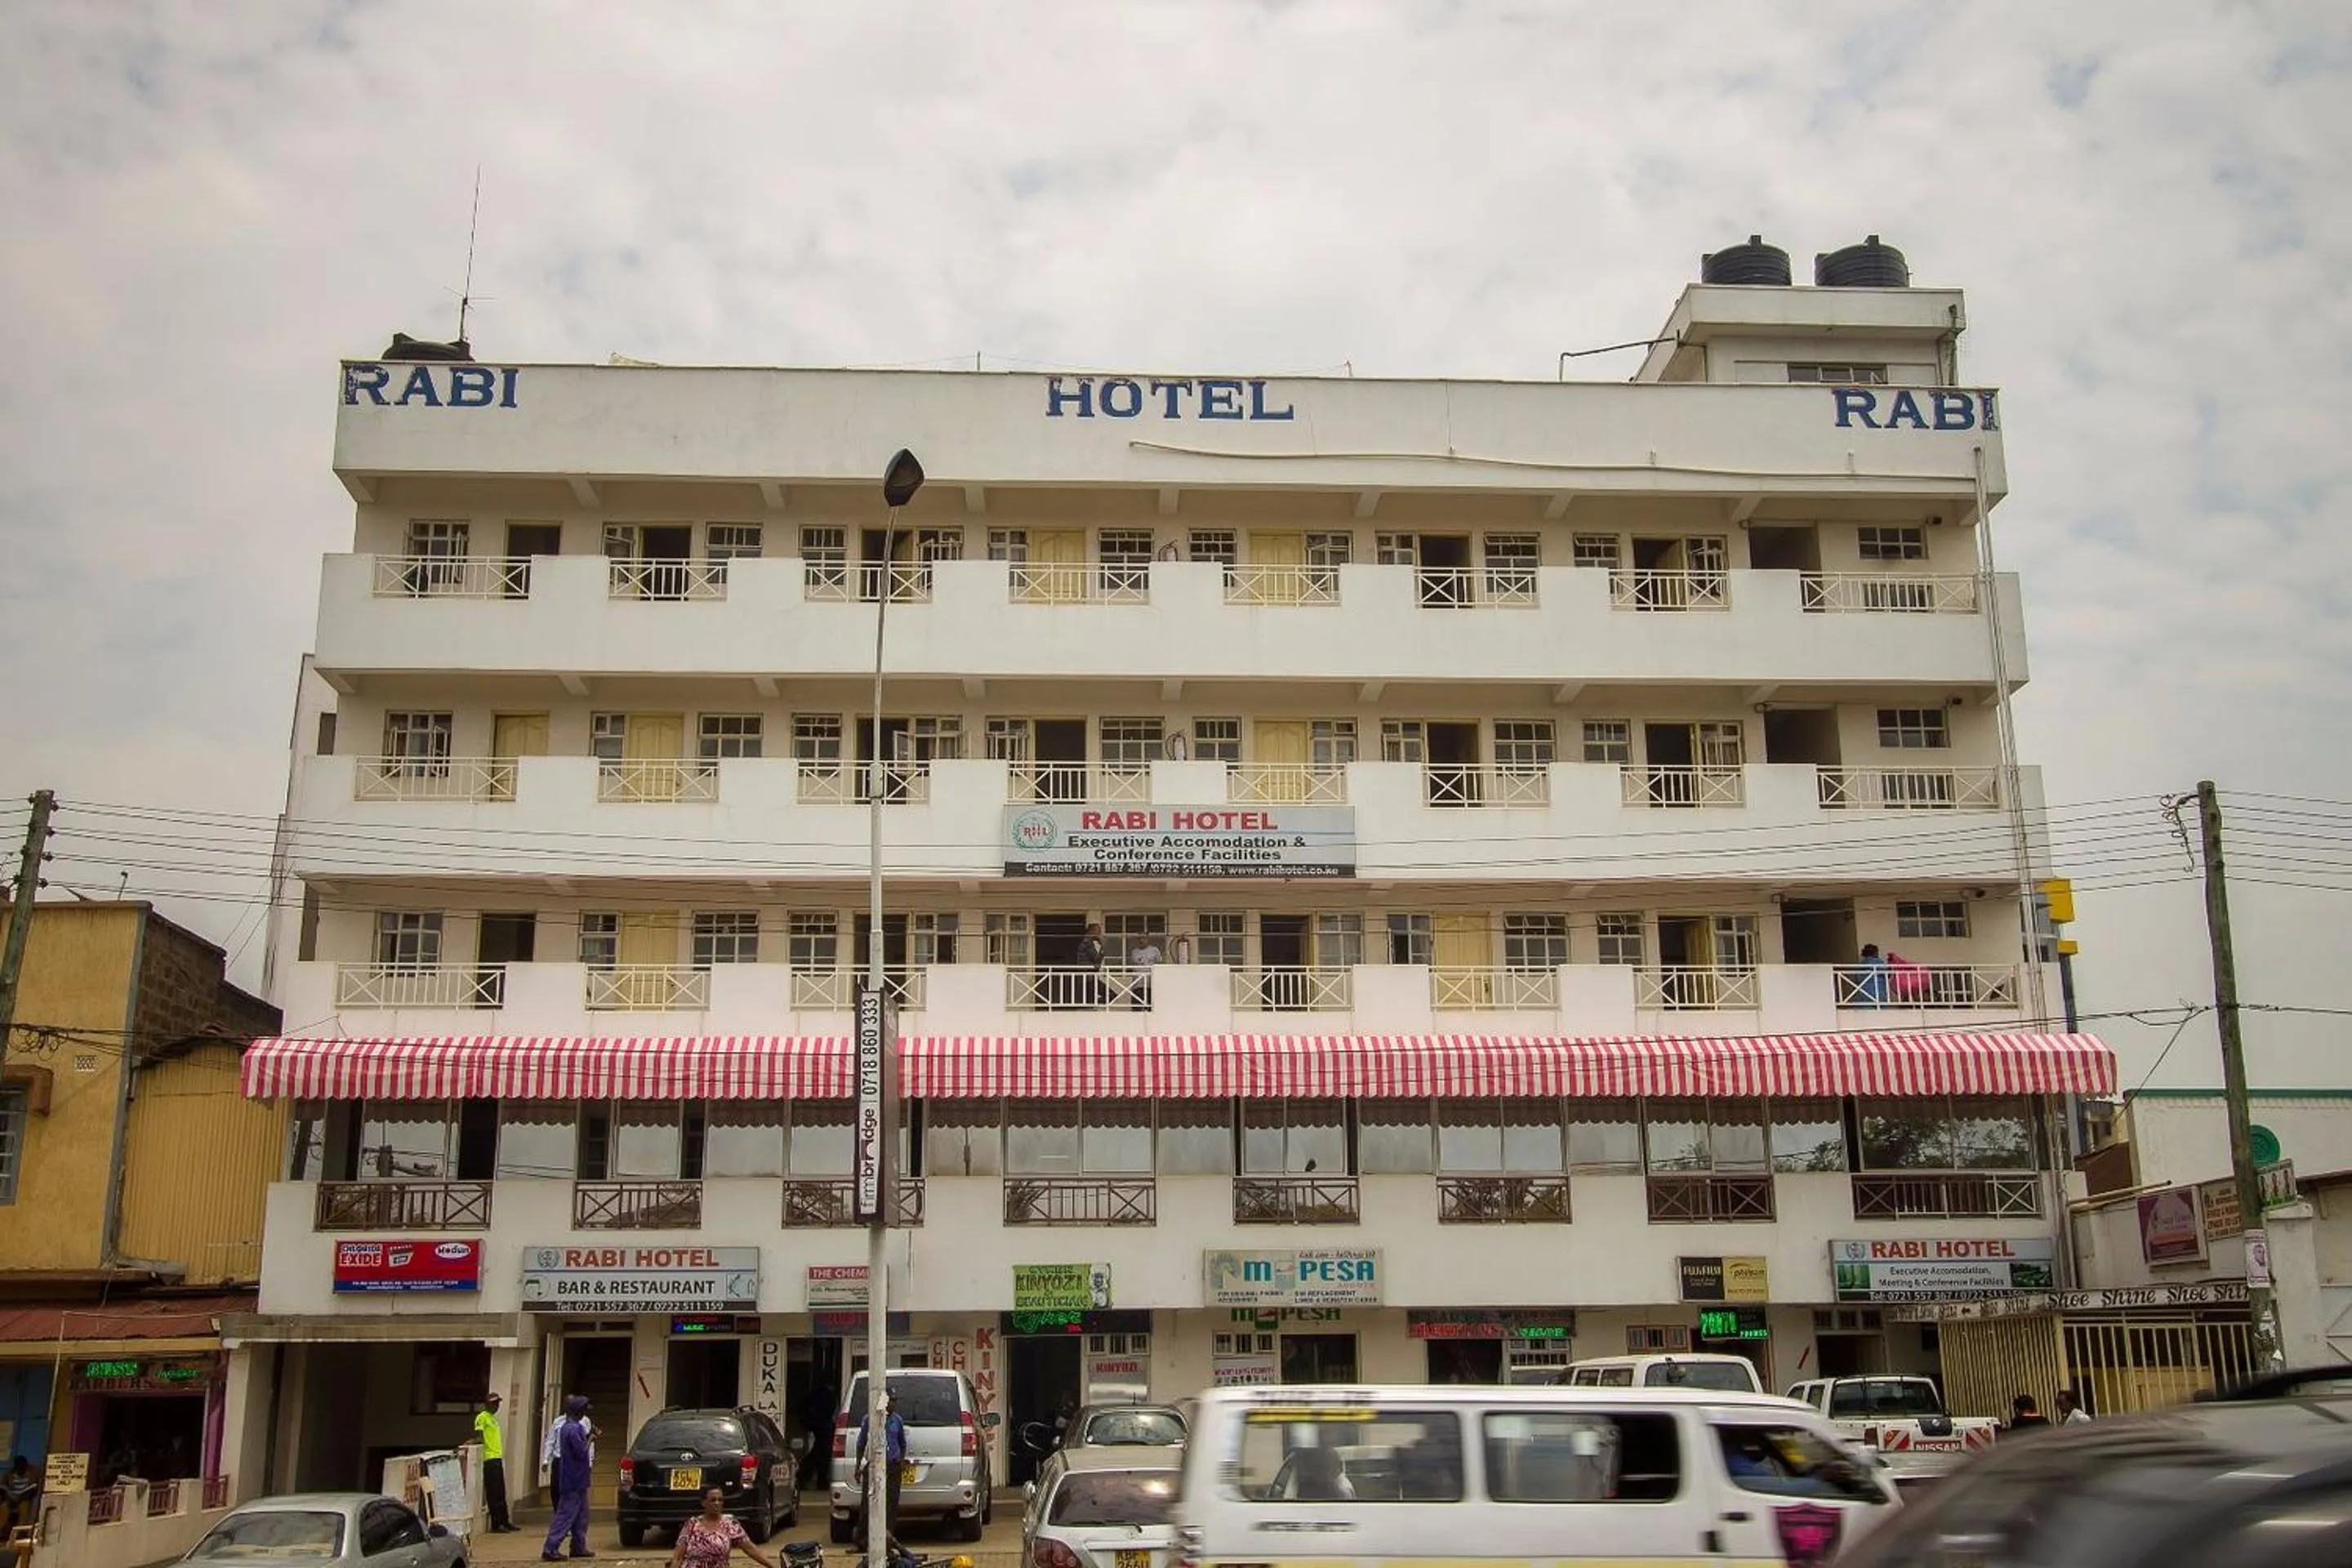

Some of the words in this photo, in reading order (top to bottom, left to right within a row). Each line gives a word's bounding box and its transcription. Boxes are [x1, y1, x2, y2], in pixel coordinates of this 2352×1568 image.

[343, 364, 519, 408] RABI
[1046, 376, 1294, 420] HOTEL
[1832, 389, 1998, 431] RABI
[1081, 812, 1156, 831] RABI
[1172, 812, 1279, 831] HOTEL
[1068, 835, 1156, 848] Executive
[1160, 835, 1287, 848] Accomodation
[1294, 836, 1307, 848] &
[1094, 849, 1195, 861] Conference
[1201, 849, 1281, 861] Facilities
[862, 998, 878, 1024] 333
[862, 1029, 878, 1055] 860
[862, 1061, 878, 1095] 0718
[1871, 1241, 1927, 1258] RABI
[1936, 1241, 2015, 1258] HOTEL
[341, 1253, 381, 1265] EXIDE
[565, 1250, 626, 1267] RABI
[635, 1250, 719, 1267] HOTEL
[813, 1267, 831, 1278] THE
[835, 1267, 869, 1278] CHEM
[1891, 1267, 1928, 1276] Executive
[557, 1281, 590, 1294] BAR
[594, 1281, 606, 1294] &
[609, 1281, 715, 1294] RESTAURANT
[1879, 1279, 1912, 1288] Meeting
[1914, 1279, 1920, 1287] &
[1922, 1279, 1968, 1287] Conference
[1969, 1278, 2005, 1287] Facilities
[2047, 1292, 2089, 1307] Shoe
[2101, 1287, 2156, 1307] Shine
[2167, 1285, 2208, 1304] Shoe
[762, 1342, 777, 1394] DUKA
[1915, 1443, 1960, 1451] NISSAN
